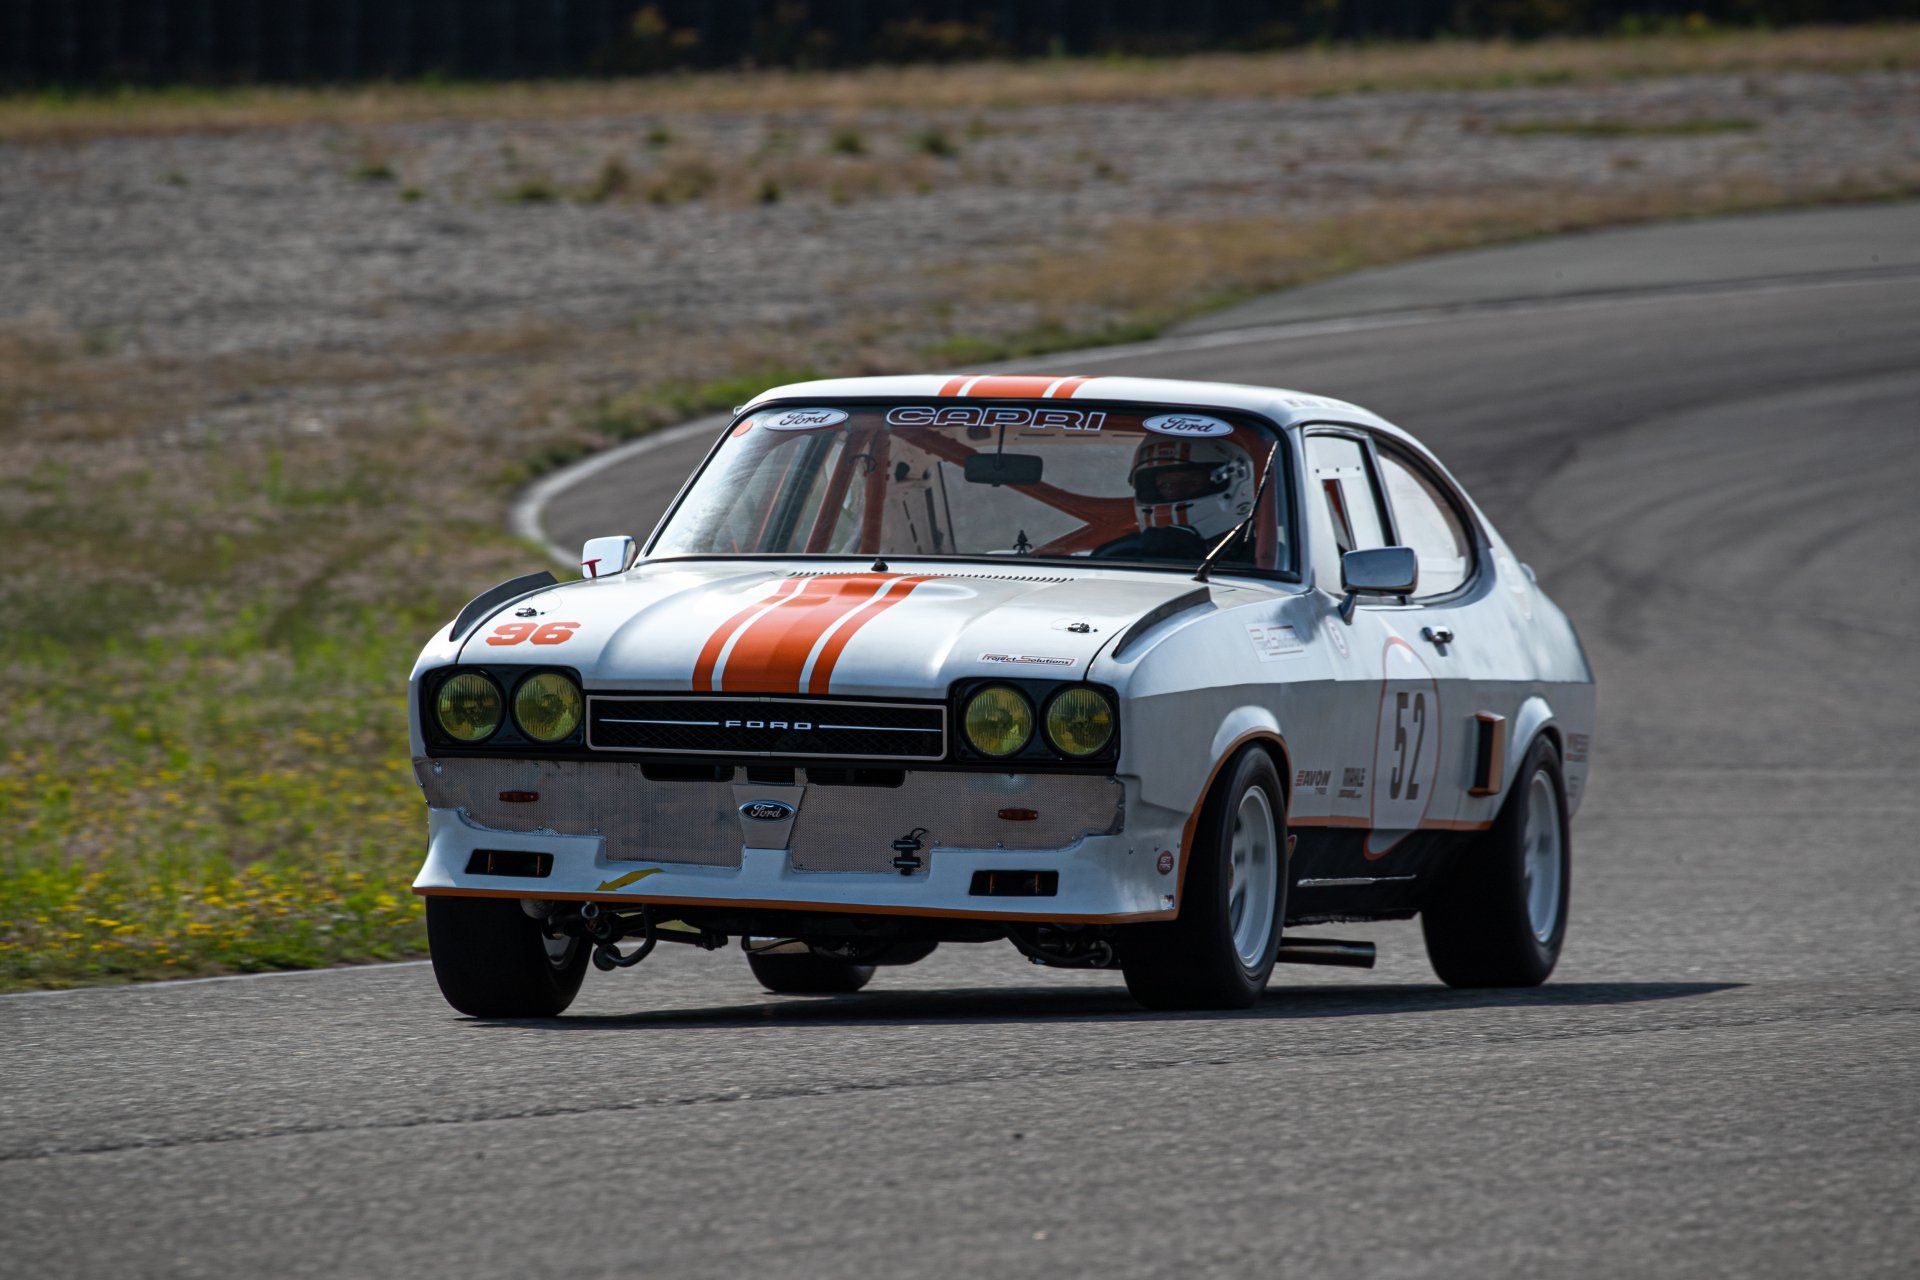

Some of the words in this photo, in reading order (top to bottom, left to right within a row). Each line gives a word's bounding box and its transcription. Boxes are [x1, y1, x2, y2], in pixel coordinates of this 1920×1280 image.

[779, 411, 831, 426] Ford
[886, 406, 1107, 431] CAPRI
[1160, 417, 1215, 432] Ford
[485, 622, 582, 646] 96
[982, 653, 1017, 663] Project
[1019, 655, 1075, 666] Solutions
[725, 720, 812, 730] FORD
[1389, 692, 1426, 800] 52
[1302, 770, 1331, 786] AVON
[750, 804, 781, 818] Ford
